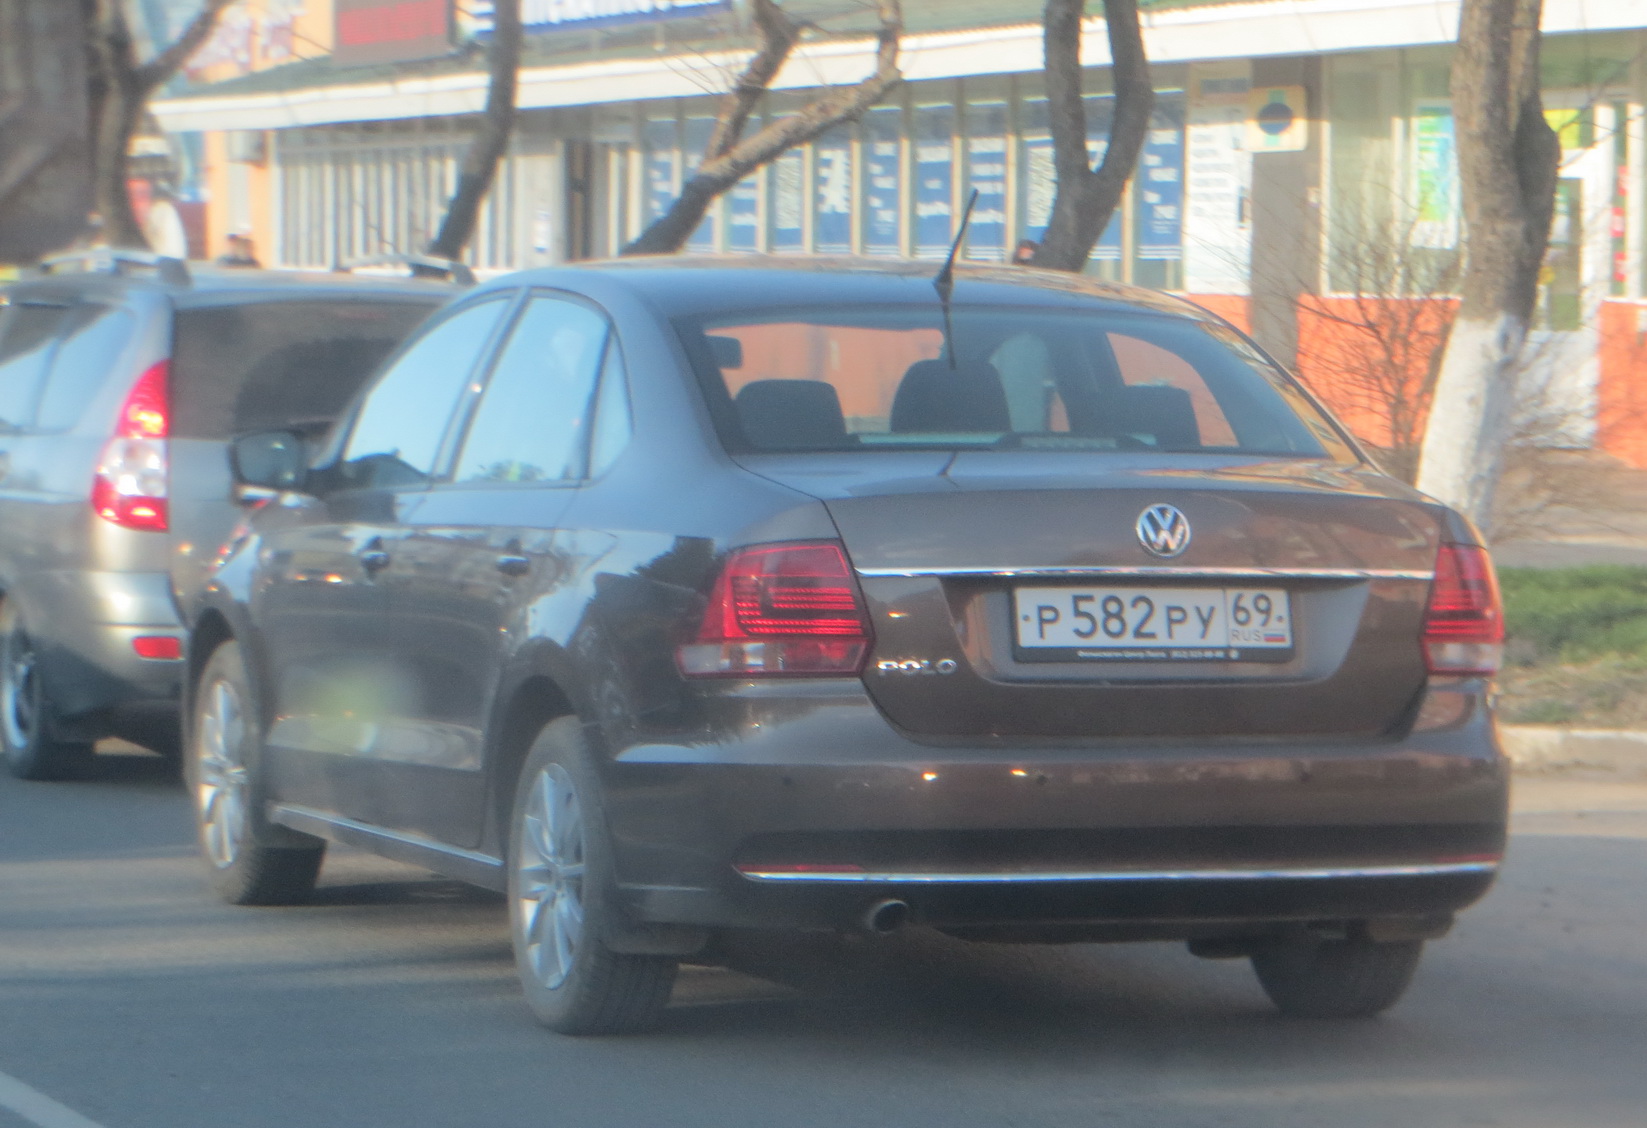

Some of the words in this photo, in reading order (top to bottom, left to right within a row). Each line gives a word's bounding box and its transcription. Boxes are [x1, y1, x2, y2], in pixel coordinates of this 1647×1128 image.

[1136, 503, 1191, 558] VW
[1232, 592, 1273, 627] 69
[1231, 629, 1262, 642] RUS
[876, 657, 957, 676] POLO
